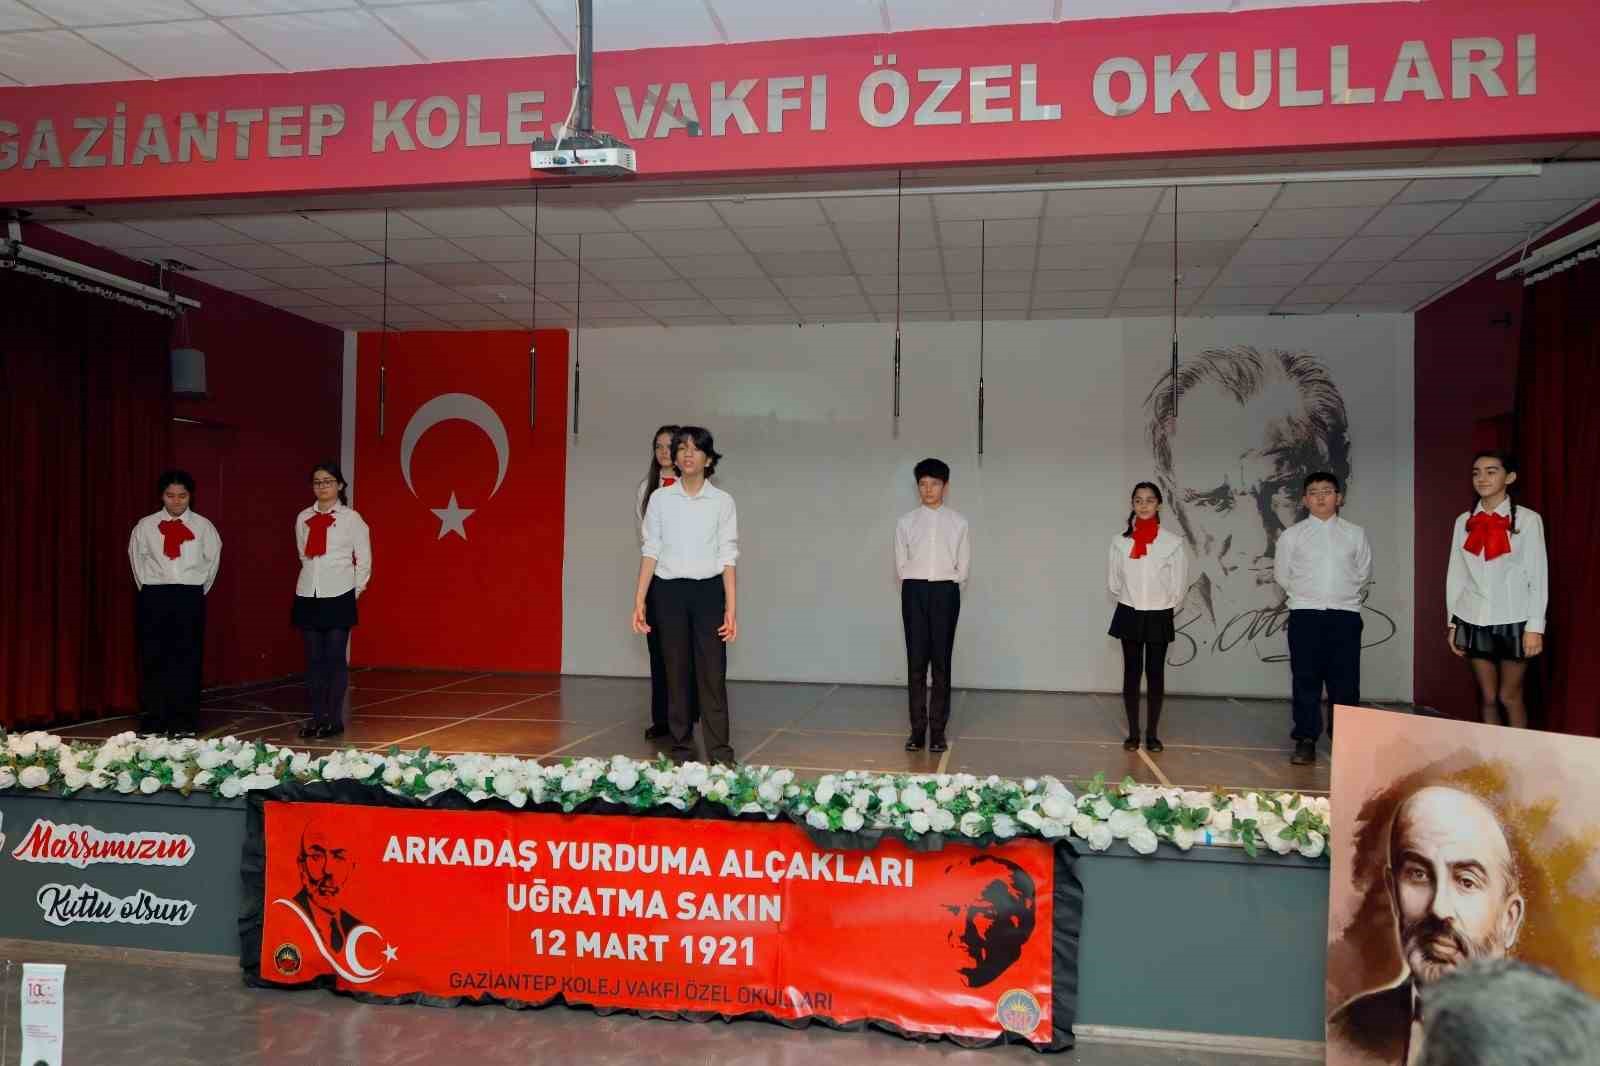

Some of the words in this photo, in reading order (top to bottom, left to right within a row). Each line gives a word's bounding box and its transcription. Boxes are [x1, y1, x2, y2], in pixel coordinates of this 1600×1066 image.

[0, 102, 345, 170] GAZİANTEP
[614, 74, 827, 138] VAKFI
[858, 55, 1061, 127] ÖZEL
[1093, 34, 1537, 118] OKULLARI
[382, 835, 538, 872] ARKADAŞ
[546, 840, 712, 876] YURDUMA
[719, 848, 914, 889] ALÇAKLARI
[38, 887, 116, 921] Kutlu
[120, 892, 189, 921] olsun
[506, 878, 667, 920] UĞRATMA
[676, 893, 782, 922] SAKIN
[530, 928, 566, 957] 12
[576, 931, 670, 962] MART
[680, 934, 754, 966] 1921
[449, 969, 557, 992] GAZİANTEP
[561, 979, 620, 996] KOLEJ
[627, 981, 680, 999] VAKFI
[685, 980, 733, 1003] ÖZEL
